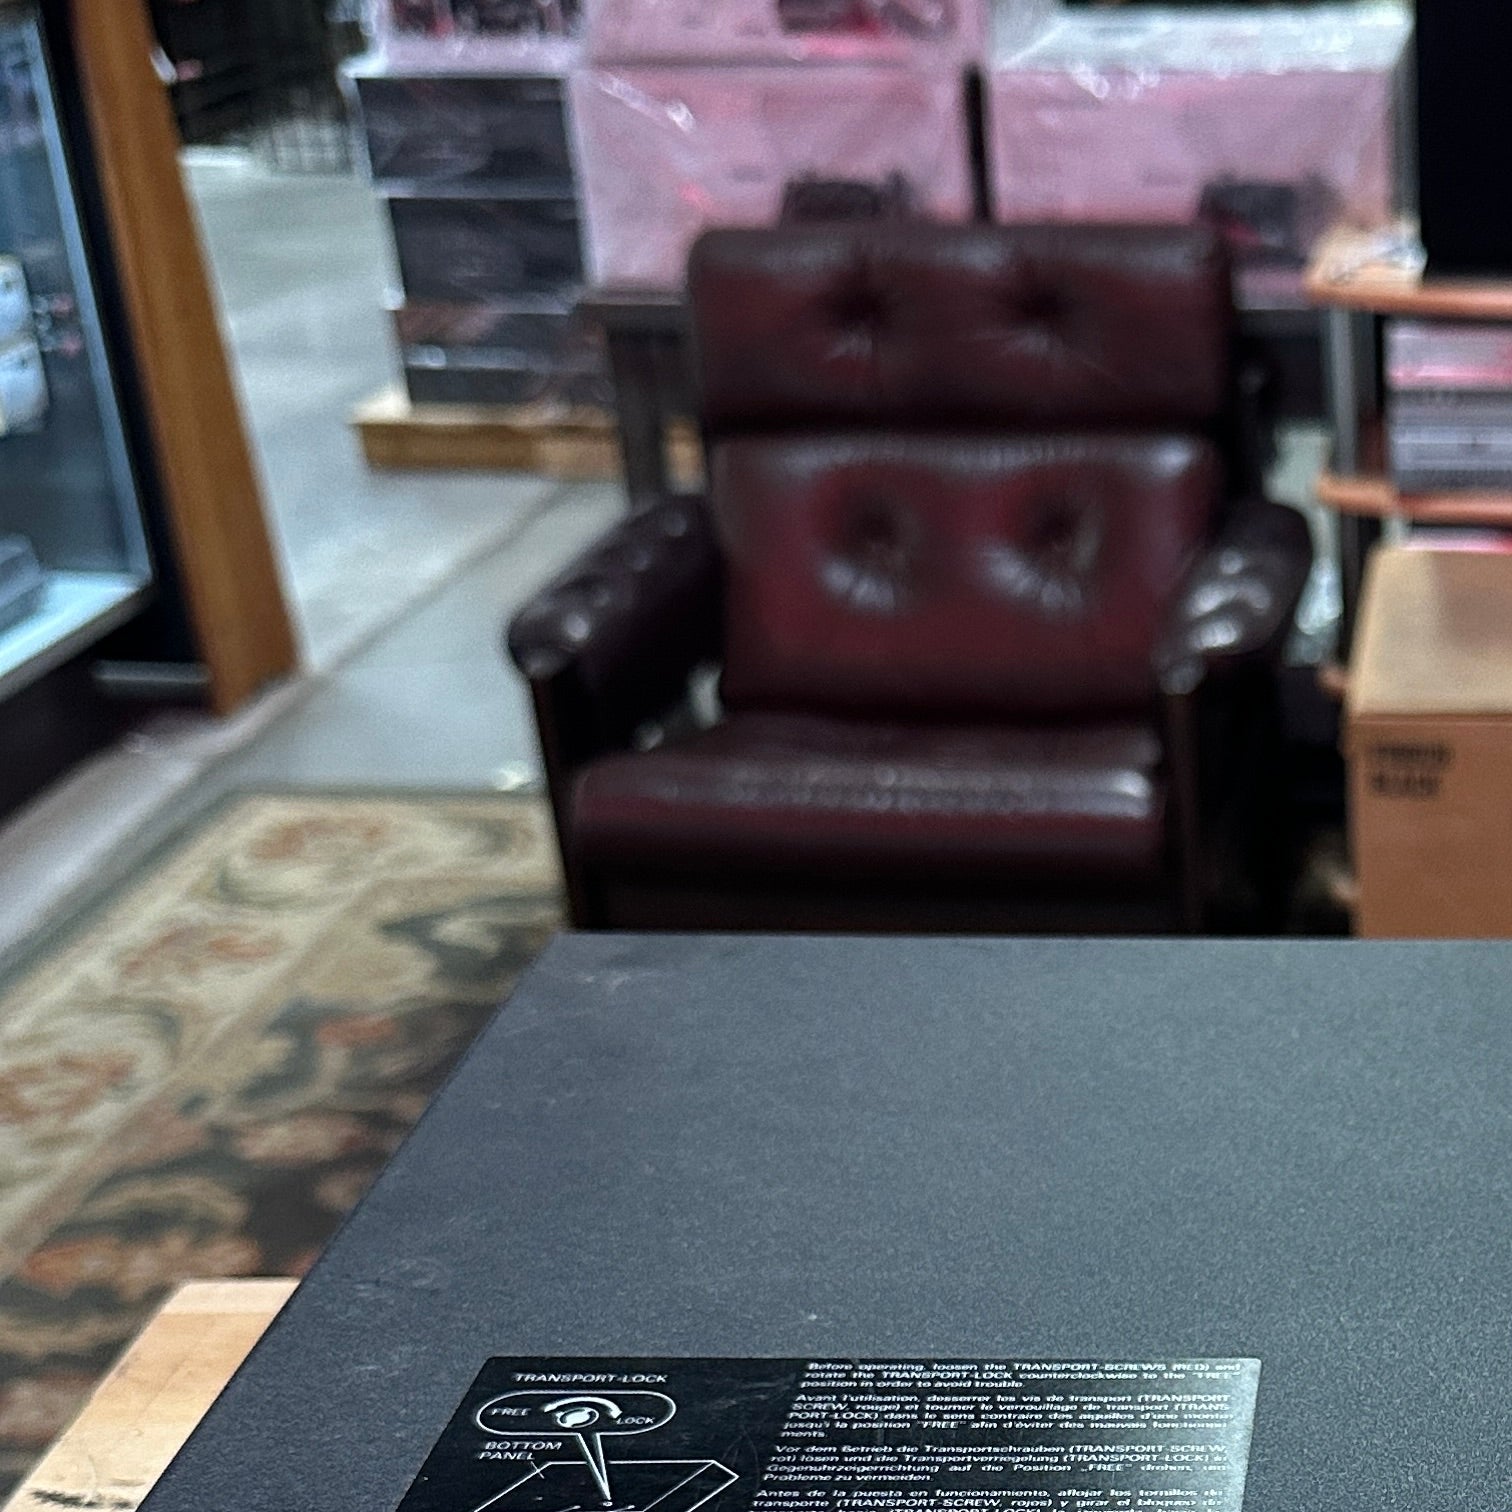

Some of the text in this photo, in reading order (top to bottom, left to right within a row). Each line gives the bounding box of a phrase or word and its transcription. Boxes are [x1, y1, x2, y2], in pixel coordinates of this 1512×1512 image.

[808, 1362, 853, 1371] Before
[983, 1362, 1007, 1371] the
[514, 1372, 668, 1384] TRANSPORT-LOCK
[804, 1371, 847, 1380] rotate
[851, 1371, 875, 1380] the
[882, 1371, 1013, 1380] TRANSPORT-LOCK
[800, 1380, 858, 1389] position
[876, 1380, 913, 1388] order
[933, 1380, 972, 1388] avoid
[795, 1394, 837, 1402] Avant
[490, 1408, 531, 1417] FREE
[616, 1415, 655, 1425] LOCK
[484, 1441, 563, 1451] BOTTOM
[775, 1445, 802, 1453] Vor
[478, 1451, 535, 1461] PANEL
